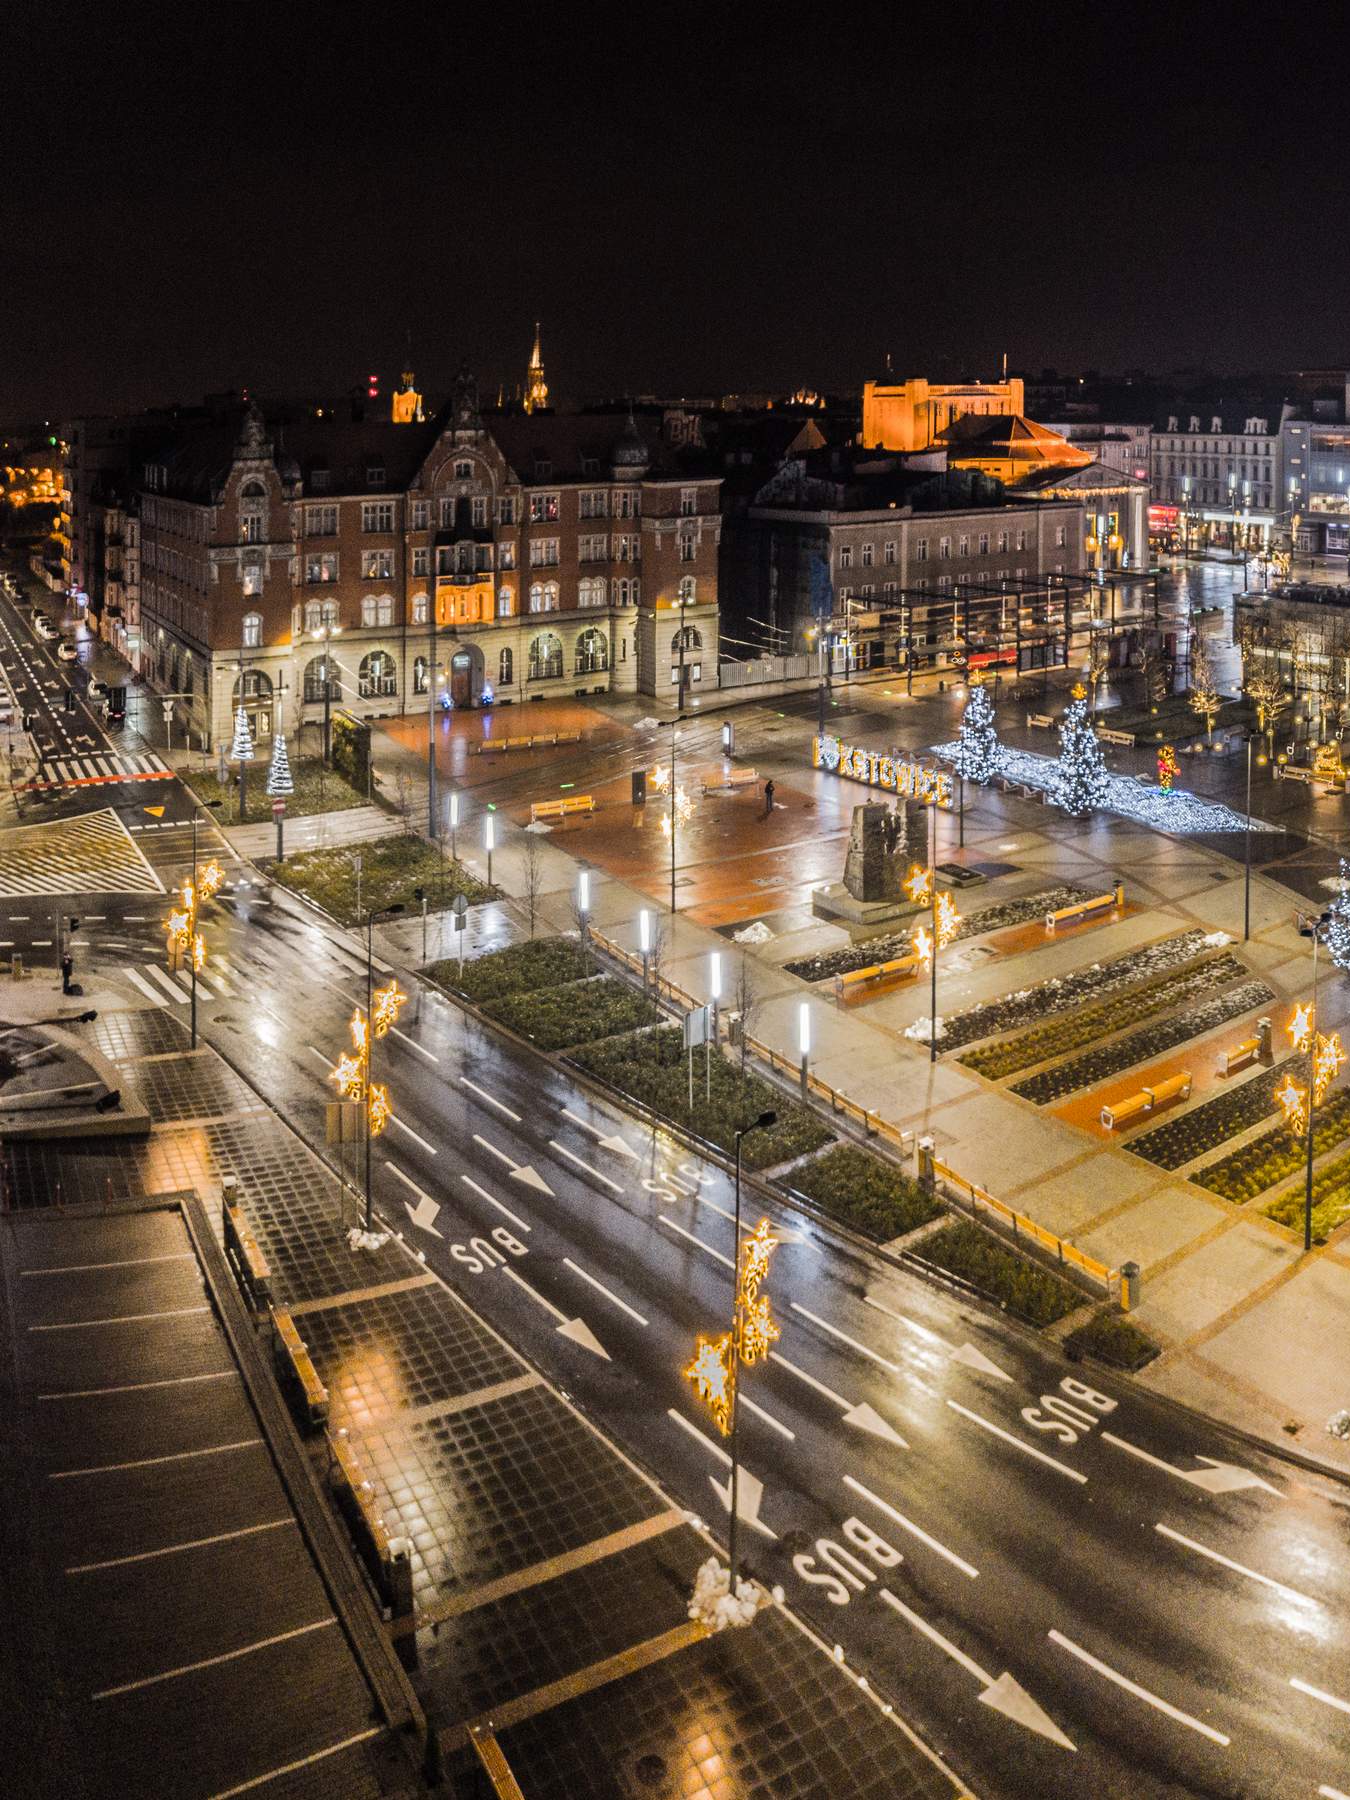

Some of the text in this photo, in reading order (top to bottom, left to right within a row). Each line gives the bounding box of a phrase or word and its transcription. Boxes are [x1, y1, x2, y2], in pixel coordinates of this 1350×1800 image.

[839, 741, 953, 807] KATOWICE
[641, 1163, 716, 1202] BUS
[450, 1227, 529, 1274] BUS
[1021, 1376, 1118, 1443] BUS
[792, 1516, 904, 1605] BUS
